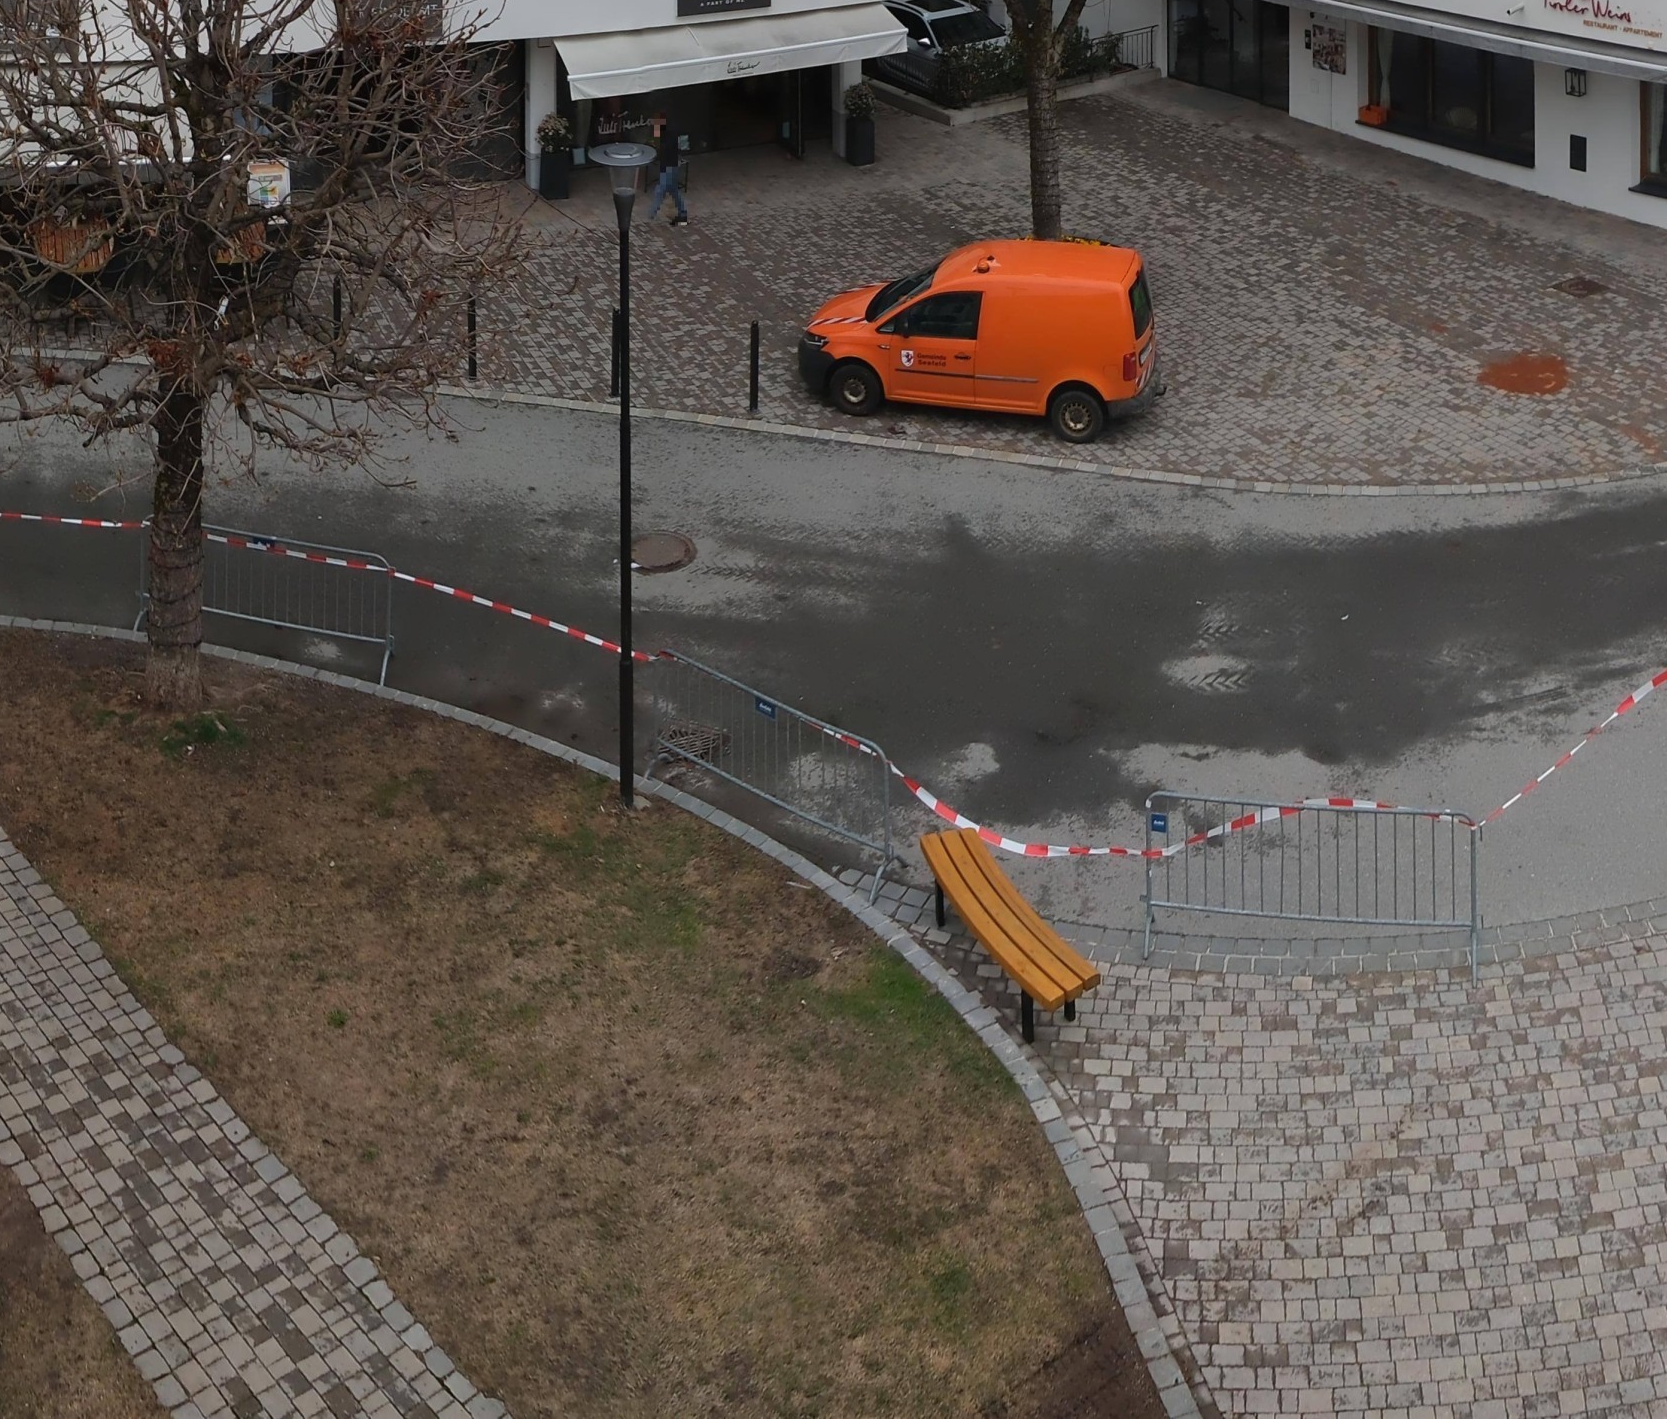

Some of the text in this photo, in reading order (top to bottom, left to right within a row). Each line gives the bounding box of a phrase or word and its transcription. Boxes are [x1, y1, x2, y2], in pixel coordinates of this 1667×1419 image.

[1582, 19, 1663, 39] RESTAURANT APPARTEMENT
[917, 352, 947, 361] Gemeinde
[917, 359, 947, 368] Seefeld
